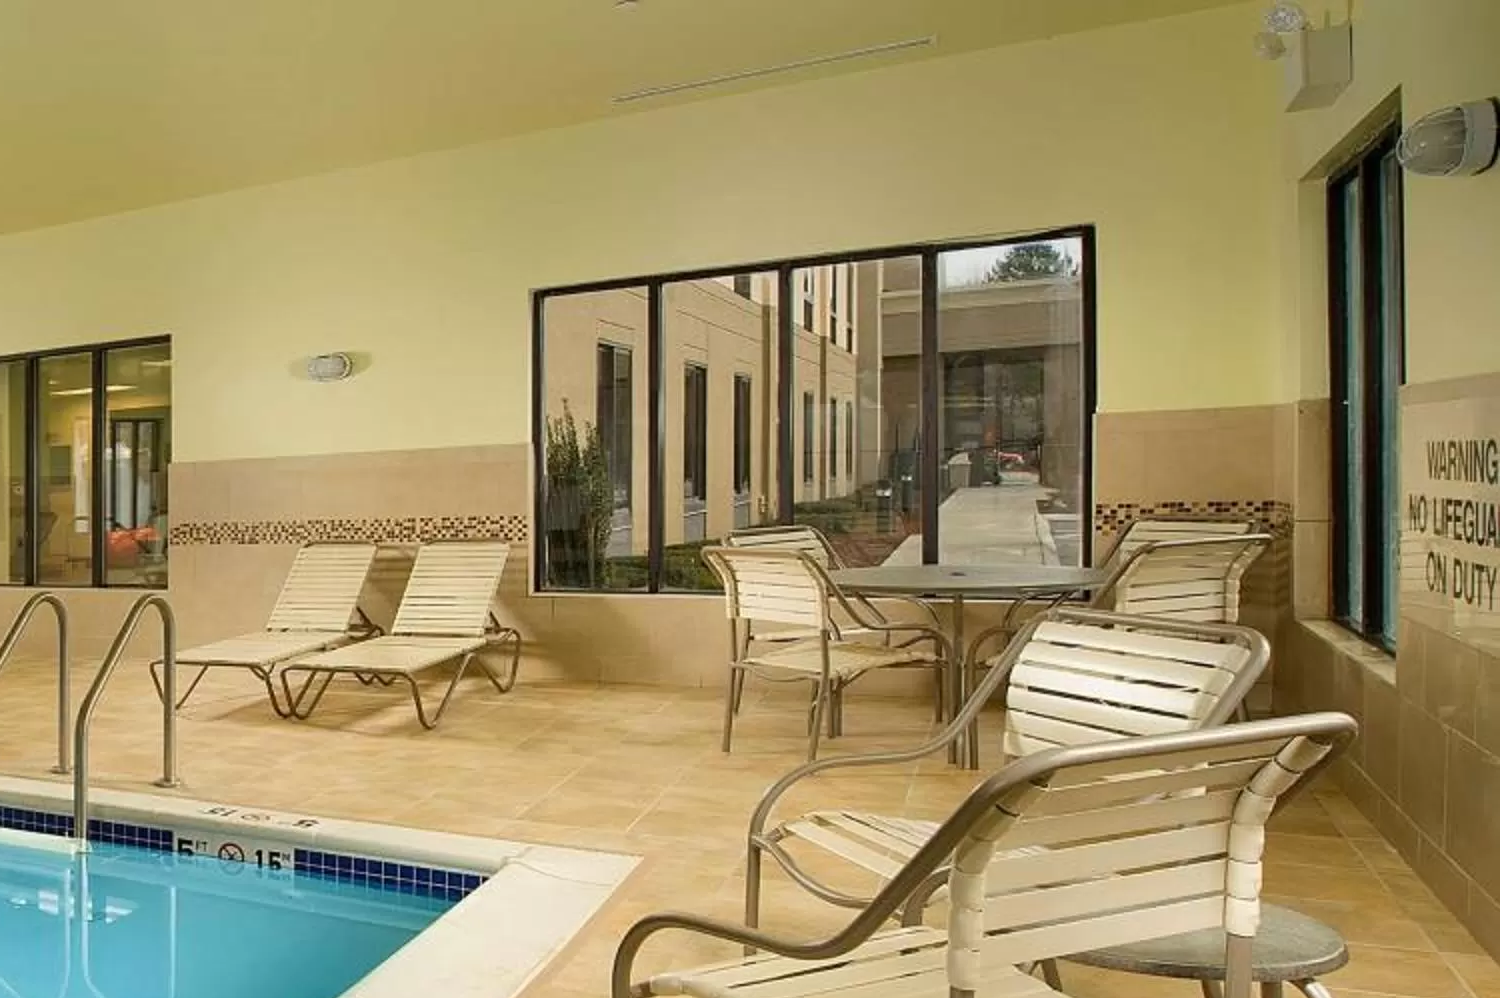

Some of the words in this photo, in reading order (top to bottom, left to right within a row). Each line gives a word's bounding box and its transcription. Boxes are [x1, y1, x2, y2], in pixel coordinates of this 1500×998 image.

[1427, 439, 1499, 485] WARNING
[1409, 493, 1428, 533] NO
[1433, 497, 1500, 548] LIFEGUA
[1426, 550, 1447, 594] ON
[1453, 557, 1497, 611] DUTY
